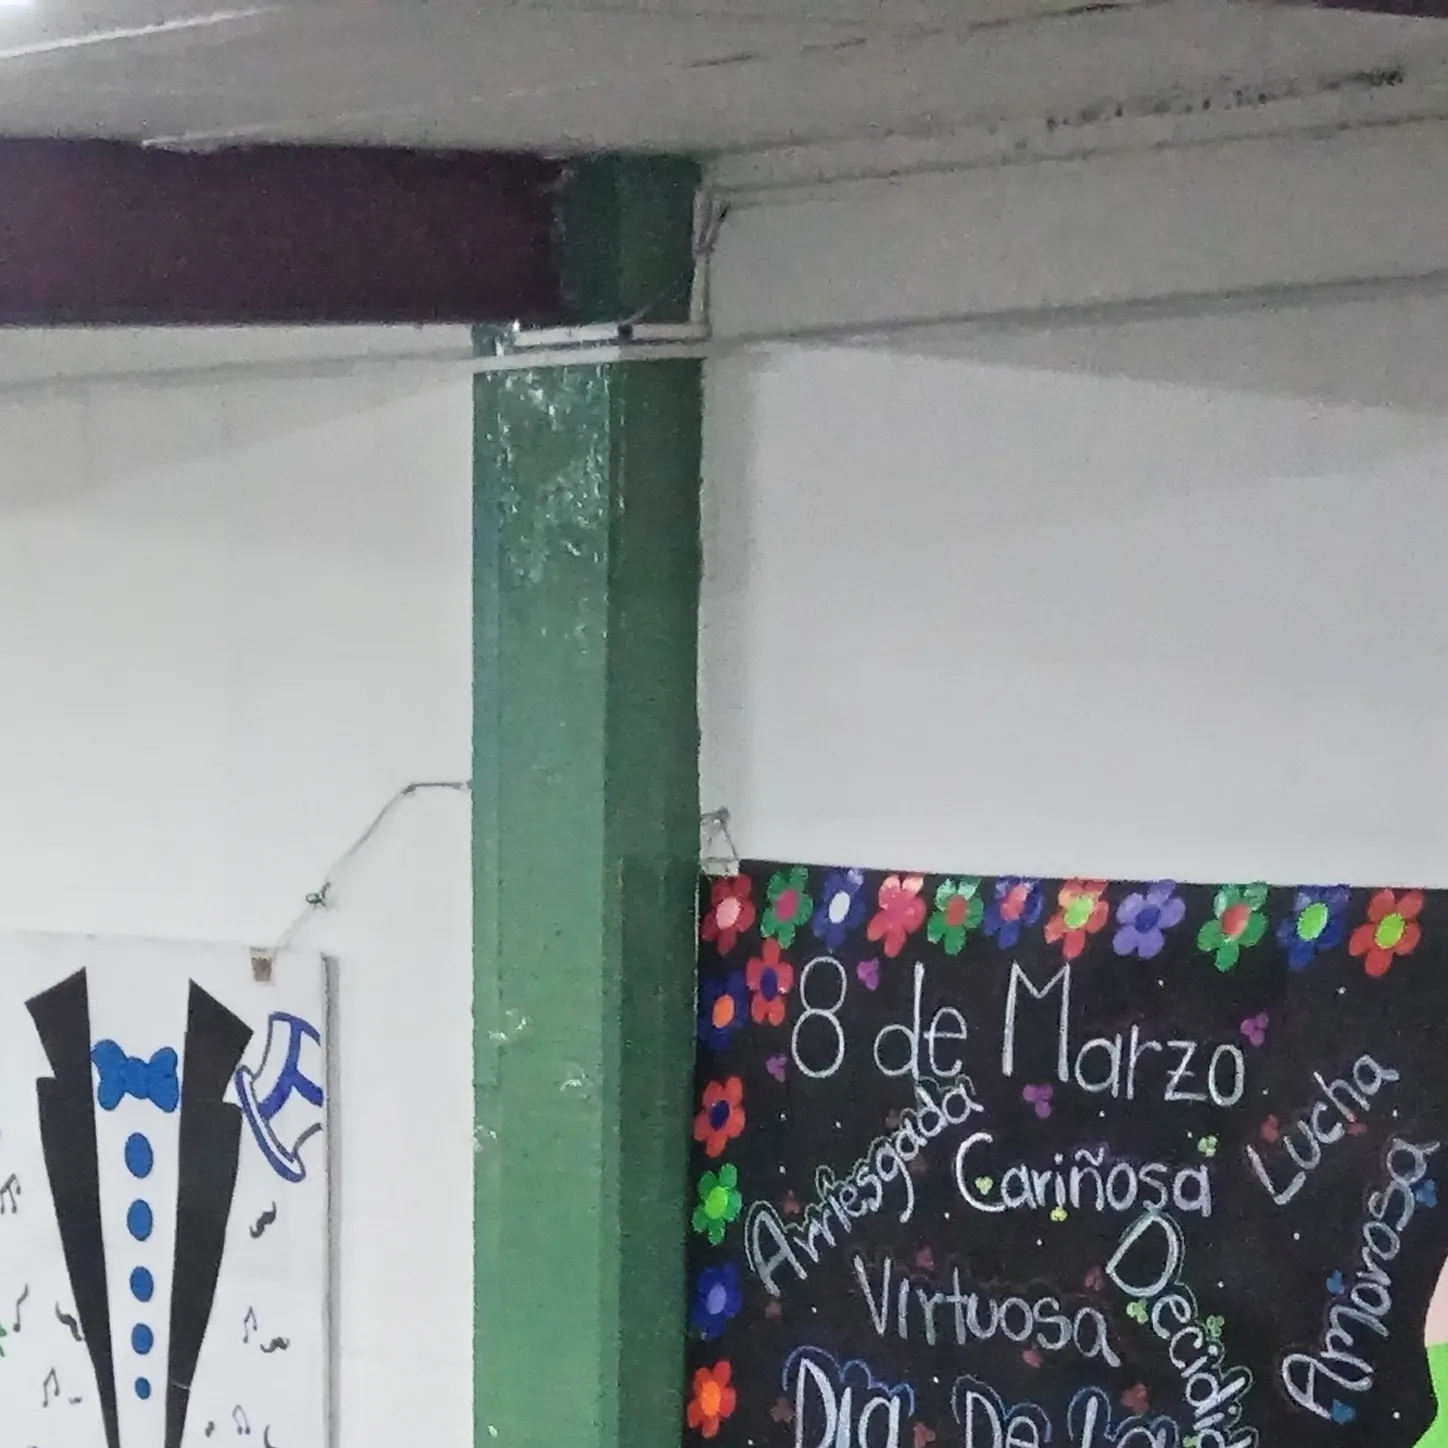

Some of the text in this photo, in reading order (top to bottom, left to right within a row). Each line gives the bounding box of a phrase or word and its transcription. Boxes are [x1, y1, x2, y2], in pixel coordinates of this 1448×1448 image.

[792, 956, 1244, 1106] 8 de Marzo
[750, 1084, 985, 1297] Arriesgada
[954, 1132, 1212, 1217] Cariñosa
[1247, 1054, 1400, 1205] Lucha
[854, 1254, 1121, 1368] Virtuosa
[1281, 1136, 1440, 1420] Amorosa
